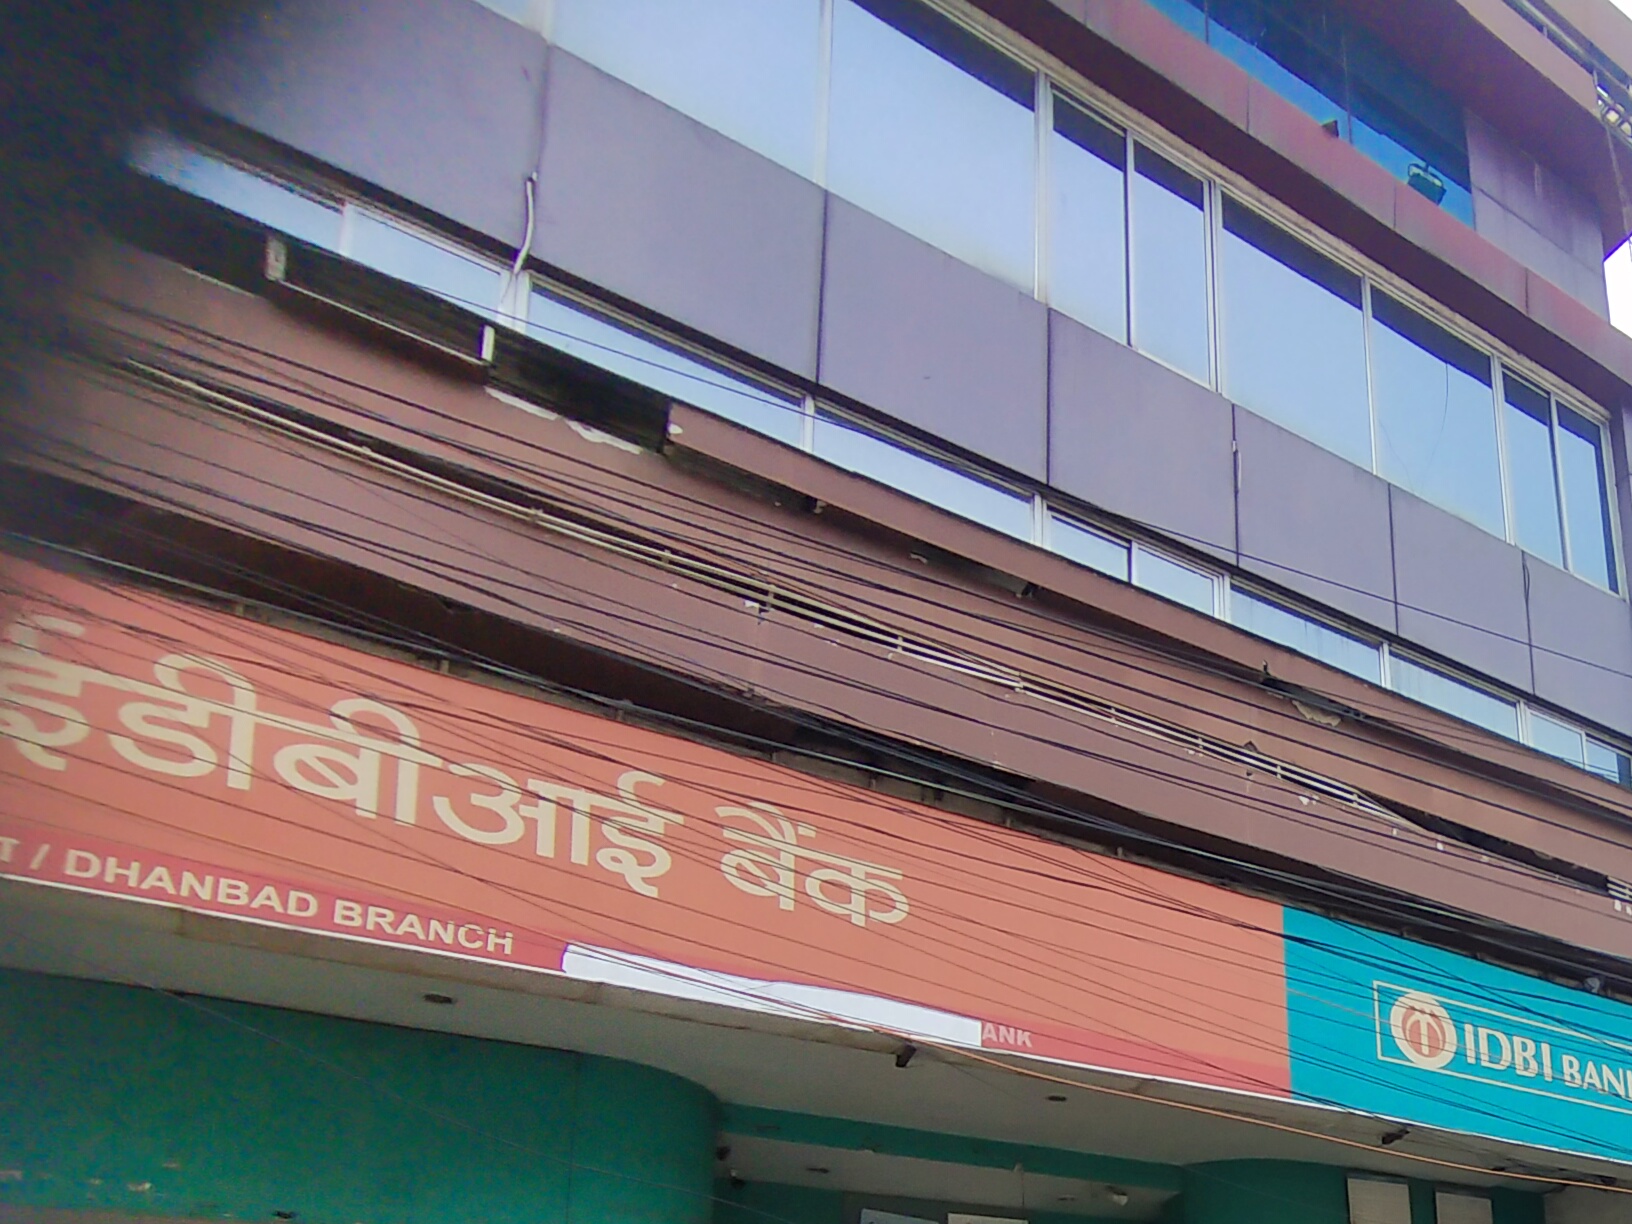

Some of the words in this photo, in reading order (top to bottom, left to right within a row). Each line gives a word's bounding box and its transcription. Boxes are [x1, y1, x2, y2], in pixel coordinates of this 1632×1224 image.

[0, 614, 684, 898] ईडीबीआई
[714, 800, 909, 927] बैंक
[65, 849, 318, 917] DHANBAD
[334, 898, 514, 955] BRANCH
[982, 1022, 1032, 1048] ANK
[1463, 1023, 1553, 1082] IDBI
